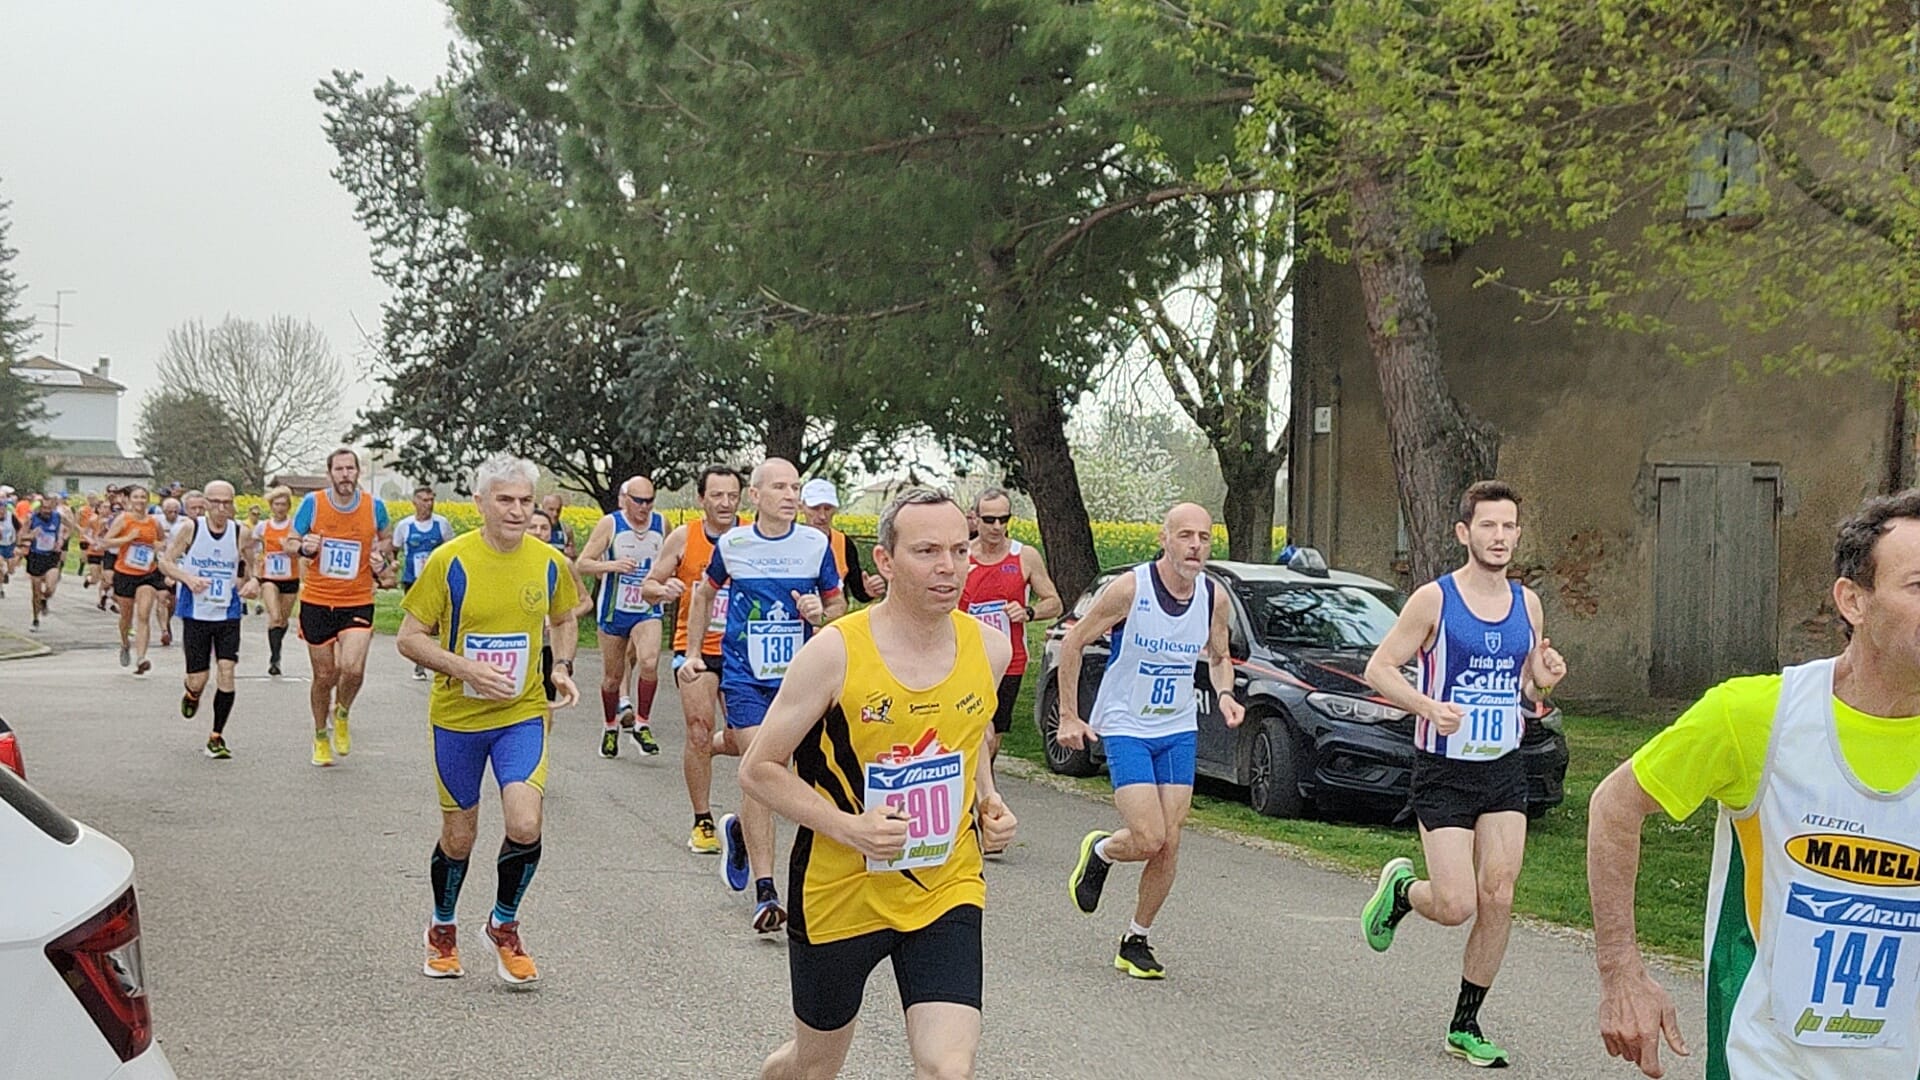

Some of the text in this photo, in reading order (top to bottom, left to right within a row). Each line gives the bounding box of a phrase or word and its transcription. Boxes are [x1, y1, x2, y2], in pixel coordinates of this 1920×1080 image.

[330, 549, 352, 568] 149
[624, 586, 643, 604] 23
[761, 636, 794, 663] 138
[1150, 677, 1177, 704] 85
[1455, 669, 1518, 690] Celtic
[1469, 708, 1503, 741] 118
[1801, 813, 1865, 834] ATLETICA
[1811, 929, 1902, 1008] 144
